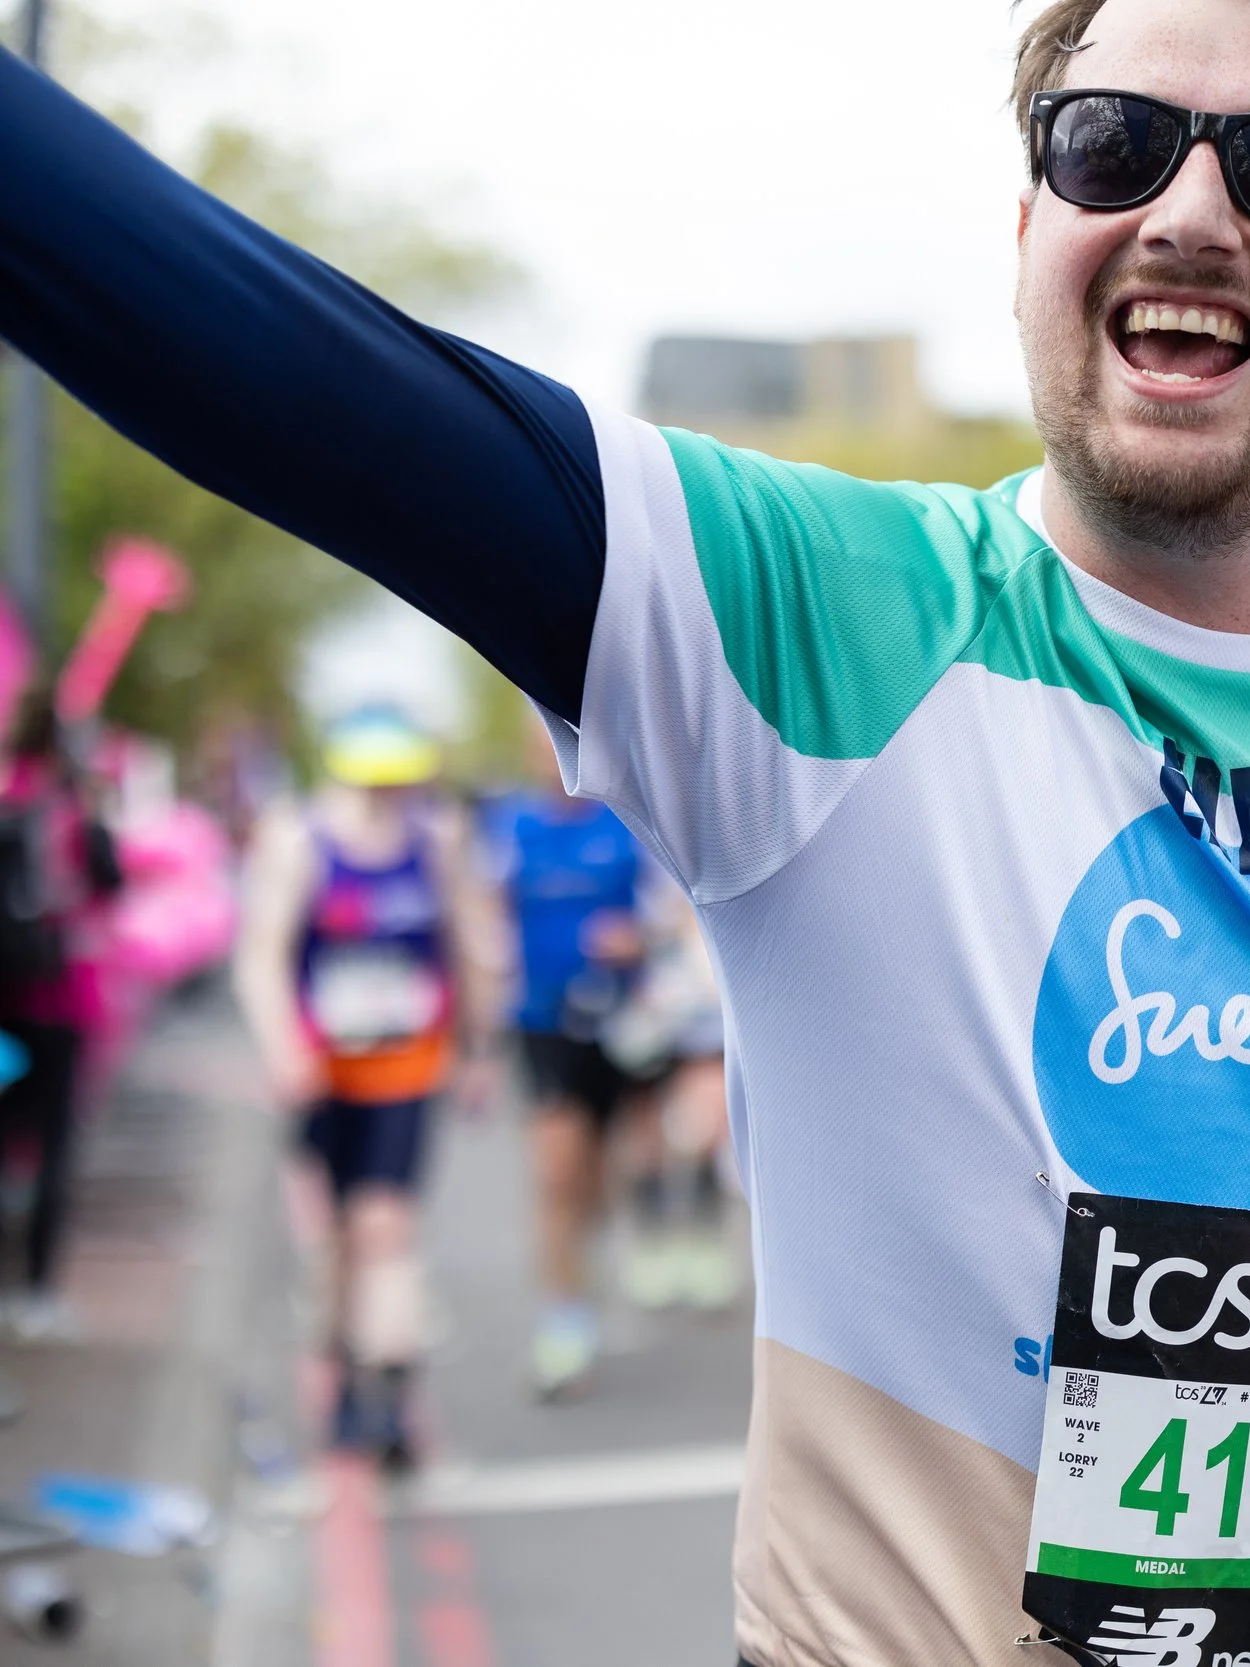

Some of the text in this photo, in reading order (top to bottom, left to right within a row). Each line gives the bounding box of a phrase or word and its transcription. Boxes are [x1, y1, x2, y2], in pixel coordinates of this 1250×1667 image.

[1175, 1383, 1200, 1401] tcs
[1064, 1417, 1101, 1432] WAVE
[1076, 1433, 1085, 1444] 2
[1058, 1451, 1099, 1467] LORRY
[1069, 1466, 1084, 1479] 22
[1135, 1560, 1186, 1576] MEDAL
